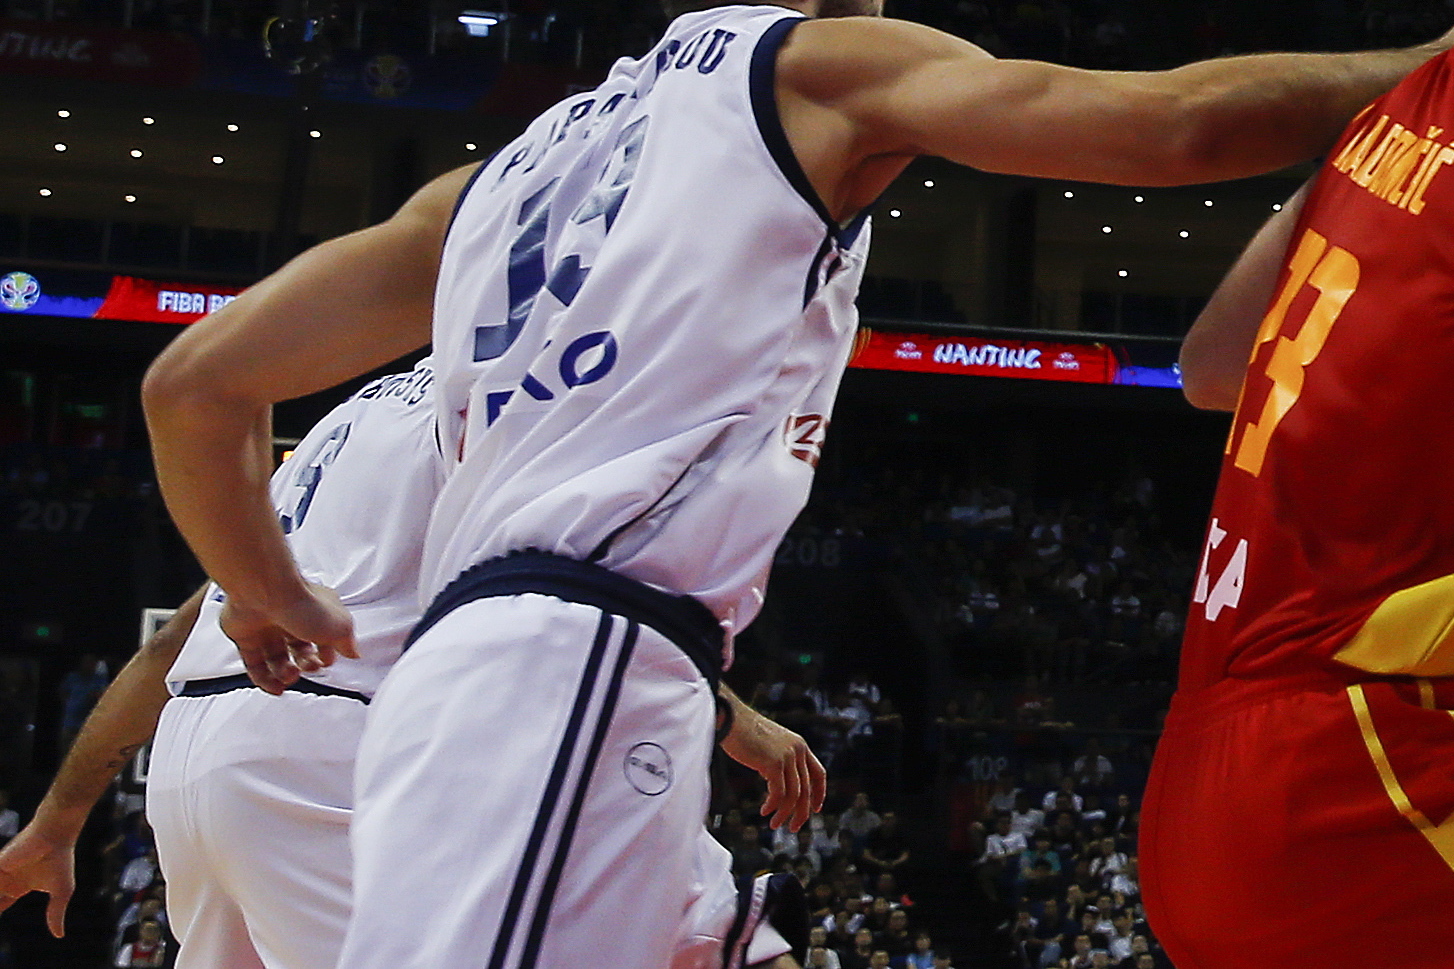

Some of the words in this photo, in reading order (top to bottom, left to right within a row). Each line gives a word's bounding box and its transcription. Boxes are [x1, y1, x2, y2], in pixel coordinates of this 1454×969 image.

[158, 290, 205, 314] FIBA
[932, 342, 1043, 369] NANTING
[17, 499, 94, 532] 207
